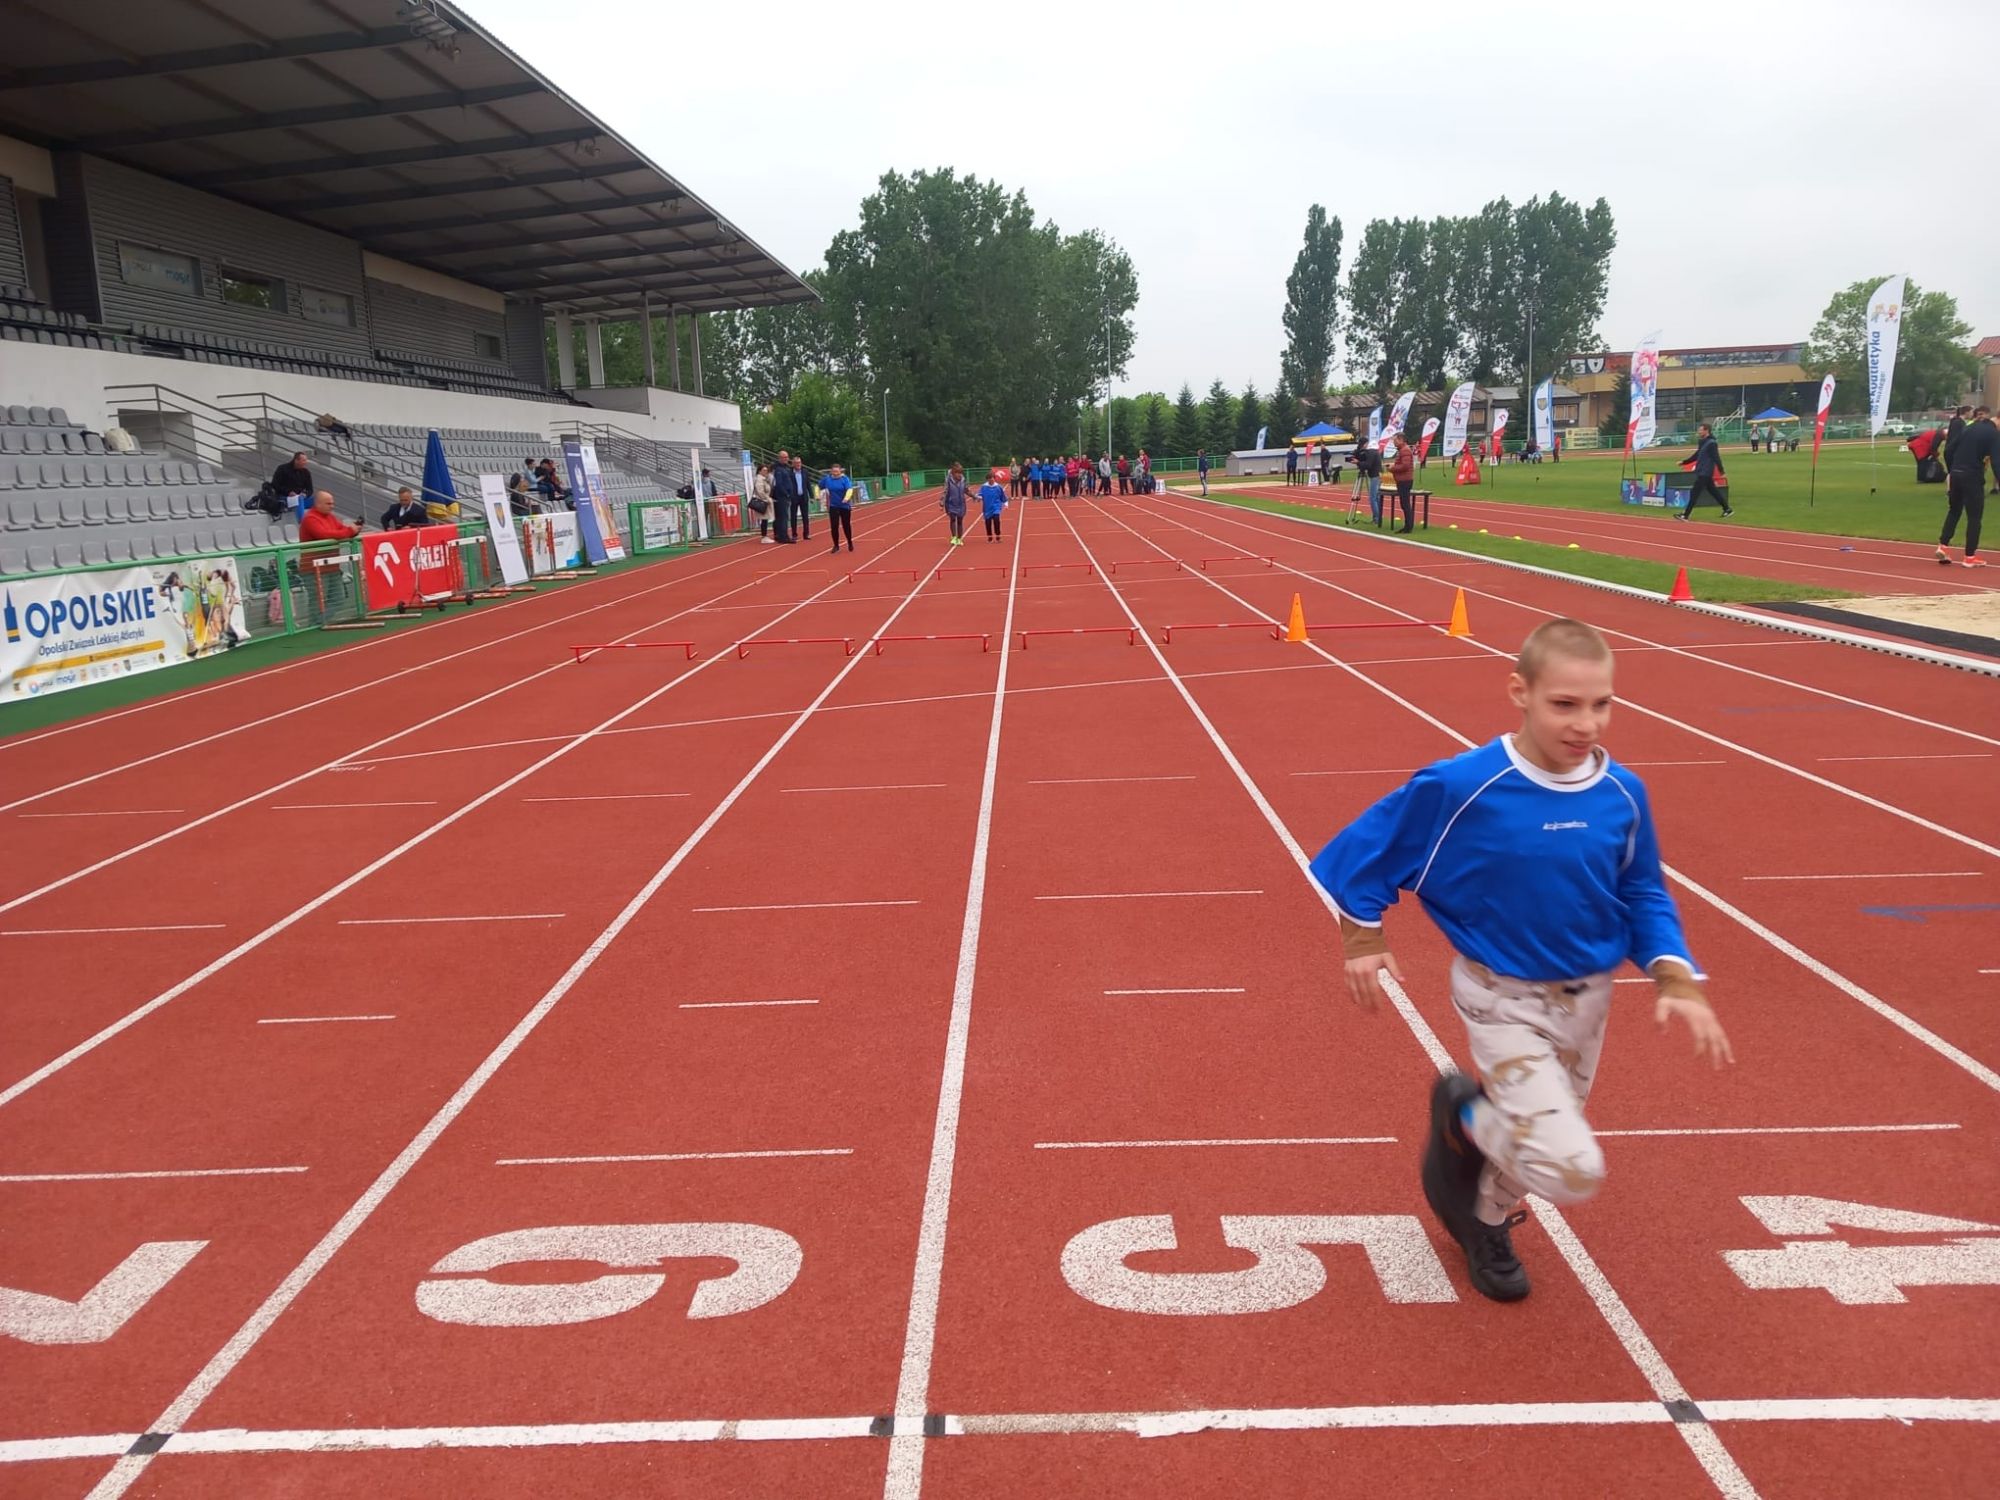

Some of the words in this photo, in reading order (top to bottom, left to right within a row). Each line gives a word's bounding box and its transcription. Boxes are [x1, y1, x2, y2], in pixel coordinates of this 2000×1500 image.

[25, 586, 156, 639] OPOLSKIE
[415, 1222, 803, 1327] 6
[1060, 1213, 1459, 1316] 5
[1721, 1193, 2000, 1305] 4
